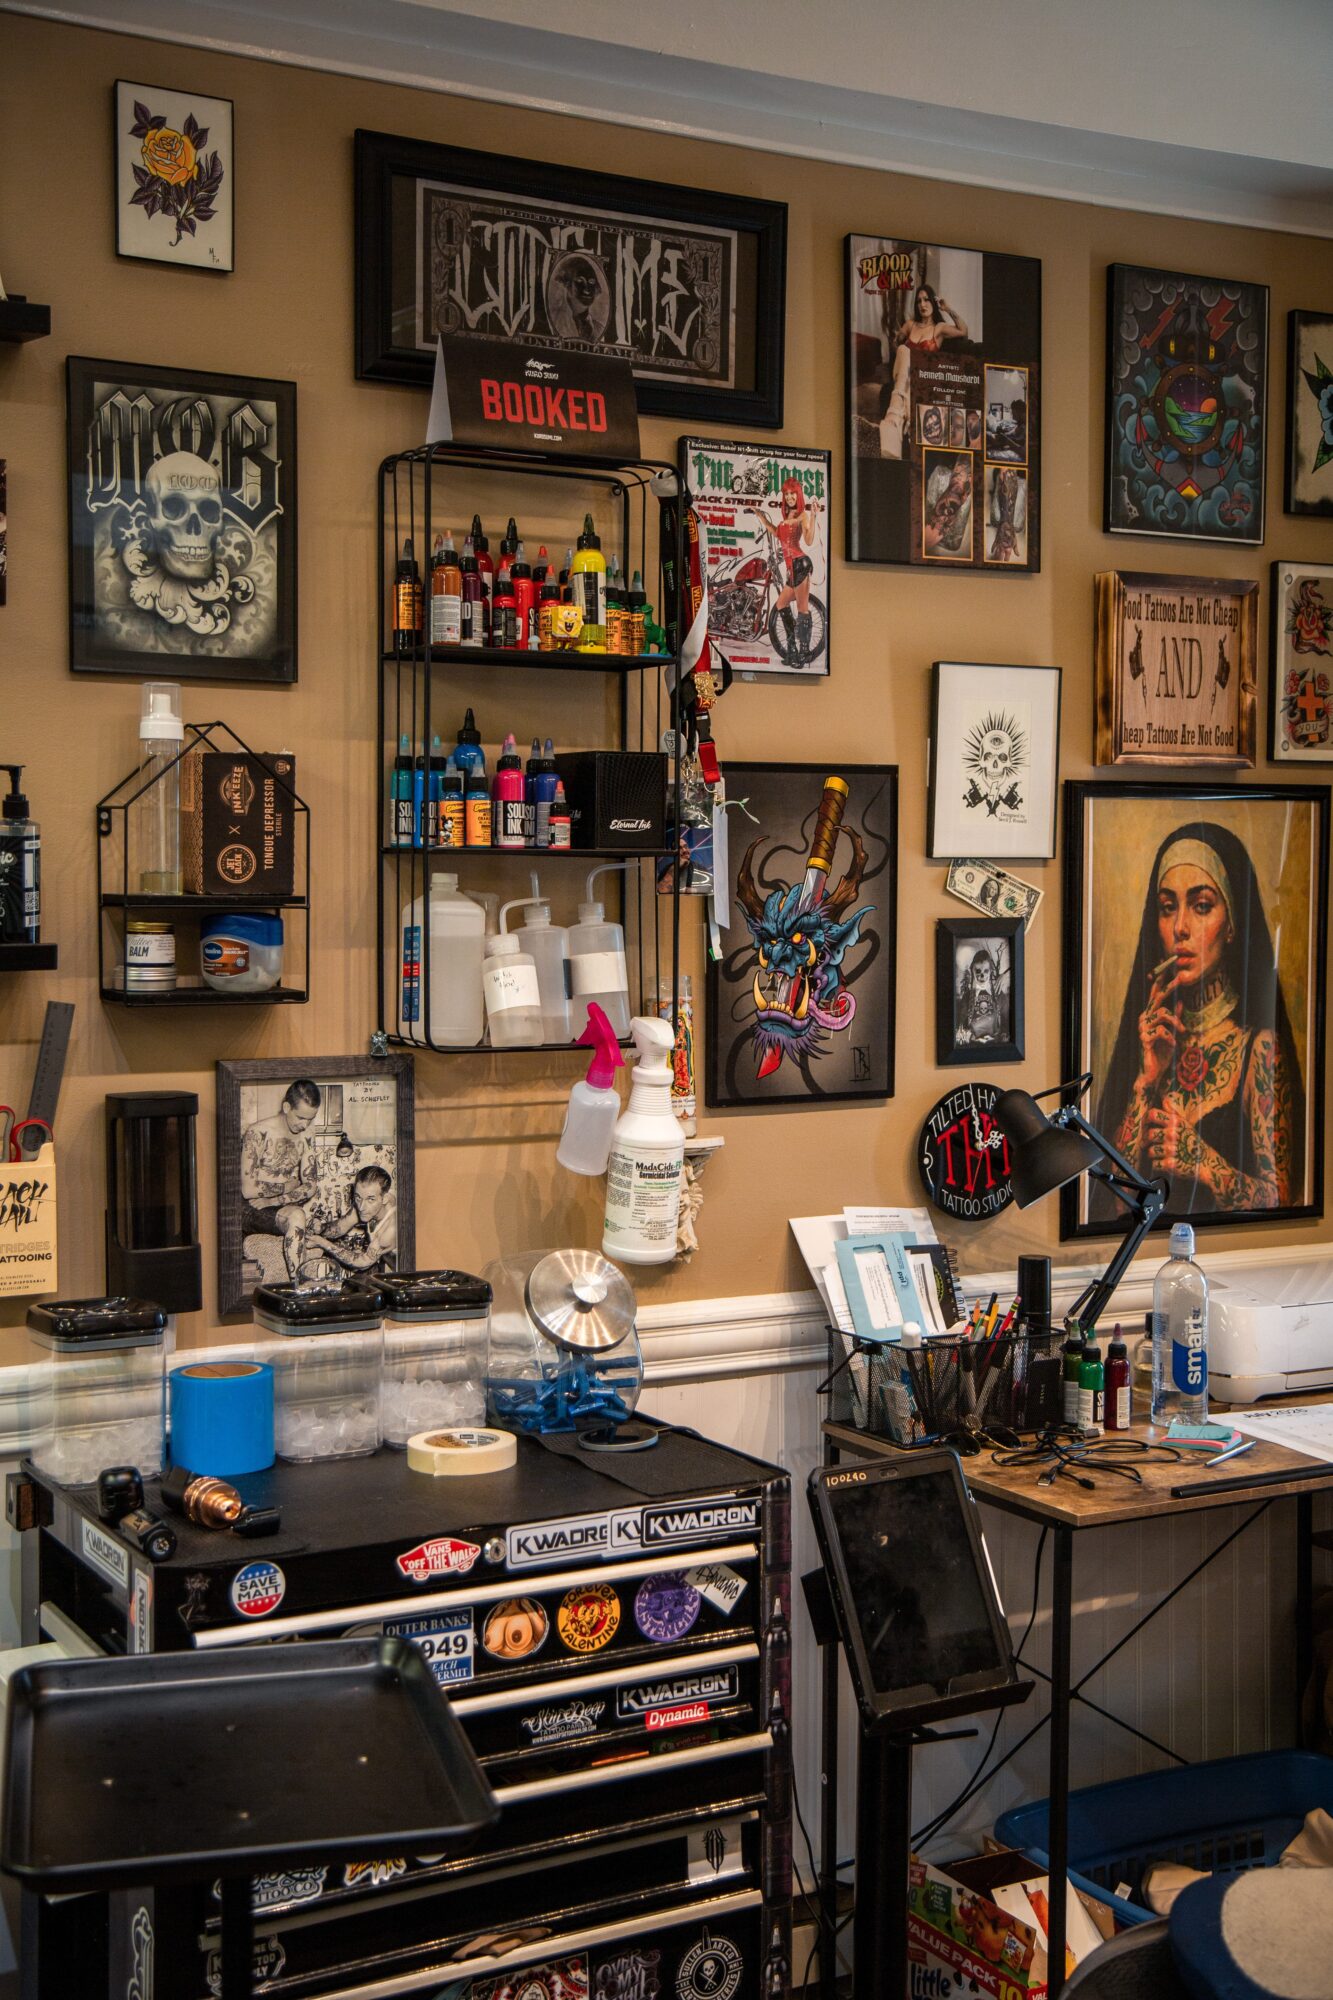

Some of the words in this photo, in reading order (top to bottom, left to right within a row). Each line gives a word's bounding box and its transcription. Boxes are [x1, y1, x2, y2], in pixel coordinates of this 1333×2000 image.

[860, 253, 911, 286] BLOOD
[890, 271, 913, 290] INK
[481, 379, 607, 433] BOOKED
[724, 496, 764, 507] STREET
[1145, 594, 1176, 624] Tattoos
[1179, 597, 1194, 624] Are
[1196, 598, 1211, 625] Not
[1213, 599, 1238, 632] Cheap
[1155, 636, 1203, 700] AND
[1124, 722, 1144, 748] heap
[1146, 723, 1178, 745] Tattoos
[1180, 725, 1195, 745] Are
[1197, 725, 1212, 746] Not
[1214, 725, 1234, 747] Good
[264, 778, 275, 832] DEPRESSOR
[507, 819, 522, 835] INK
[609, 819, 637, 832] Eternal
[637, 818, 652, 830] Ink
[264, 834, 275, 870] TONGUE
[129, 946, 149, 957] BALM
[928, 1088, 974, 1138] TILTED
[941, 1188, 981, 1216] TATTOO
[0, 1241, 51, 1254] TRIDGES
[0, 1253, 52, 1264] ATTOOING
[1185, 1315, 1202, 1385] smart
[650, 1506, 755, 1537] KWADRON
[85, 1528, 126, 1572] KWADRON
[423, 1541, 452, 1556] VANS
[427, 1554, 448, 1570] THE
[237, 1584, 281, 1601] MATT
[239, 1575, 278, 1592] SAVE
[386, 1621, 428, 1637] OUTER
[430, 1615, 469, 1630] BANKS
[432, 1660, 458, 1671] EACH
[435, 1668, 468, 1681] ERMIT
[623, 1673, 730, 1710] KWADRON
[650, 1705, 705, 1726] Dynamic
[254, 1888, 290, 1903] TTOO
[682, 1948, 702, 1977] SULLEN
[713, 1941, 726, 1952] ART
[952, 1950, 997, 1988] PACK
[911, 1962, 951, 2000] little
